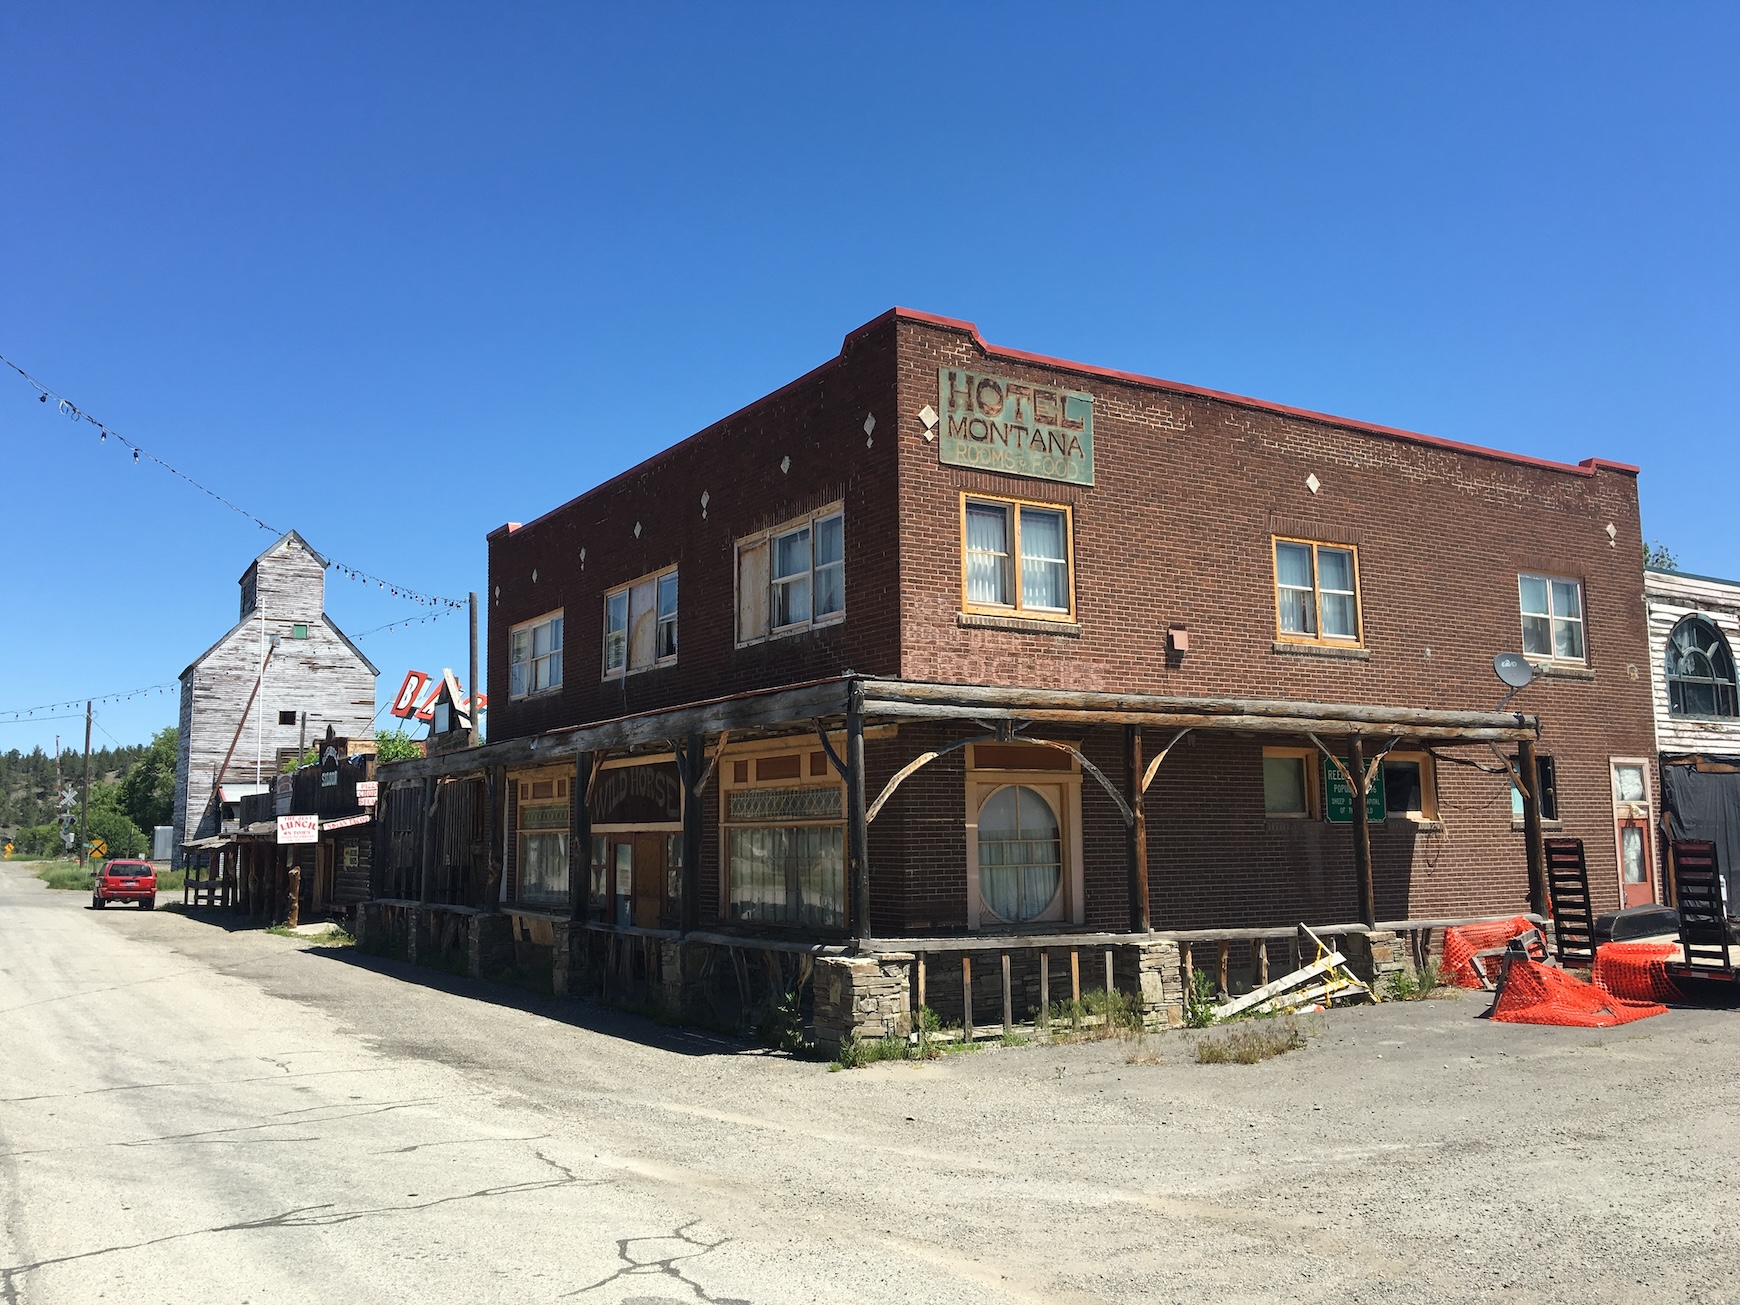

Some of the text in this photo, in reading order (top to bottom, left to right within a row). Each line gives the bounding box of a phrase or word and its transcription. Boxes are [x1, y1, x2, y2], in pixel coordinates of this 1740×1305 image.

[948, 371, 1085, 433] HOTEL
[948, 414, 1085, 462] MONTANA
[955, 442, 1016, 470] ROOMS
[1031, 455, 1079, 480] FOOD
[594, 766, 680, 820] WILD HORSE
[280, 820, 316, 831] LUNCH
